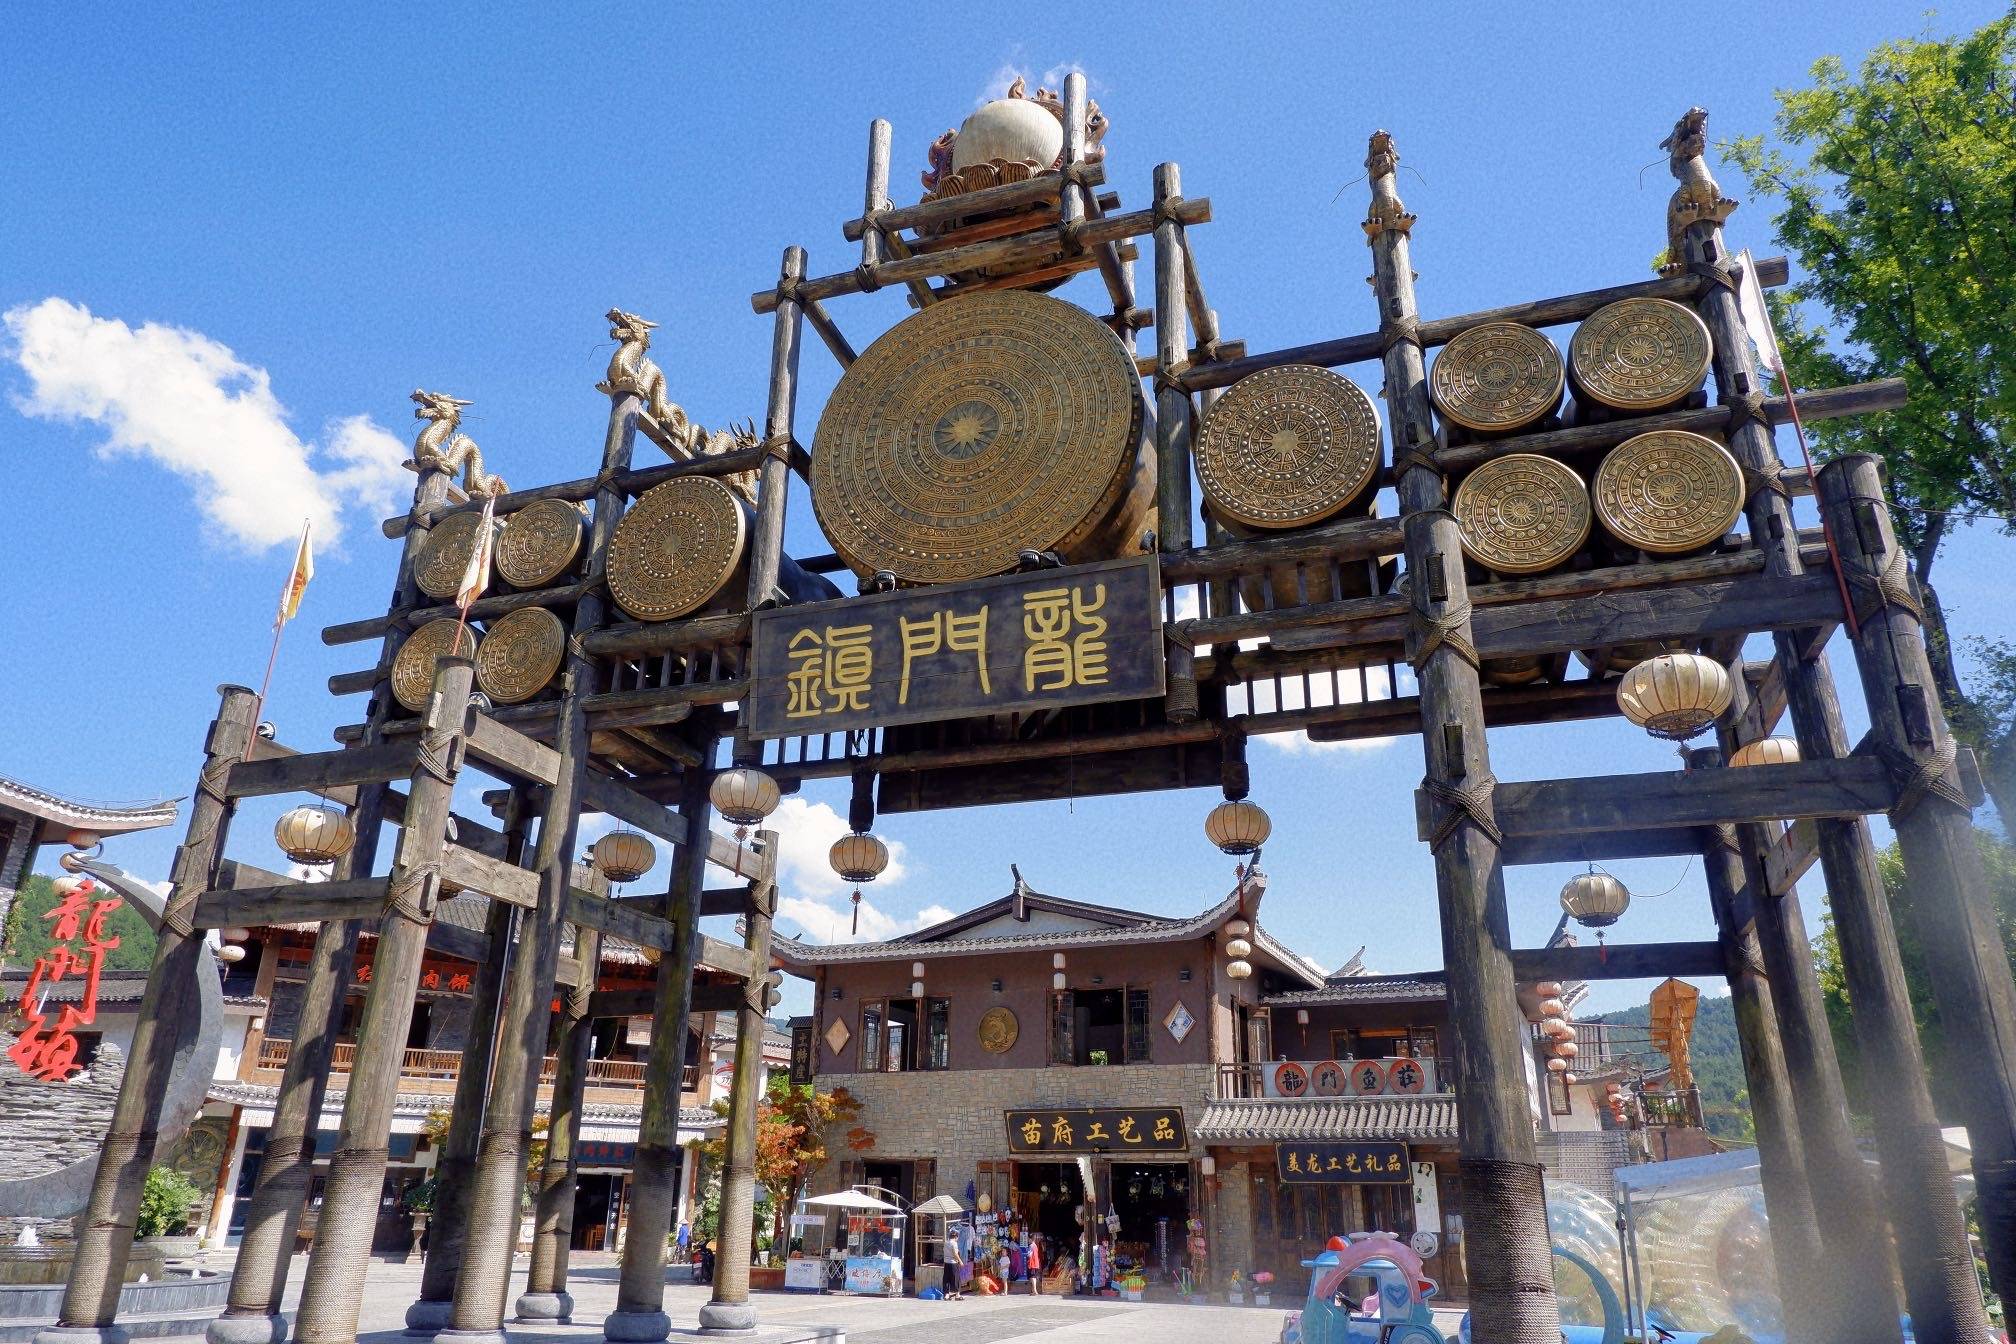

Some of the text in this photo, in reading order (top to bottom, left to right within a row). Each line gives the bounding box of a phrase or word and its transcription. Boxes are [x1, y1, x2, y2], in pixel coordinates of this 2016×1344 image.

[1021, 1116, 1175, 1146] 苗府工艺品
